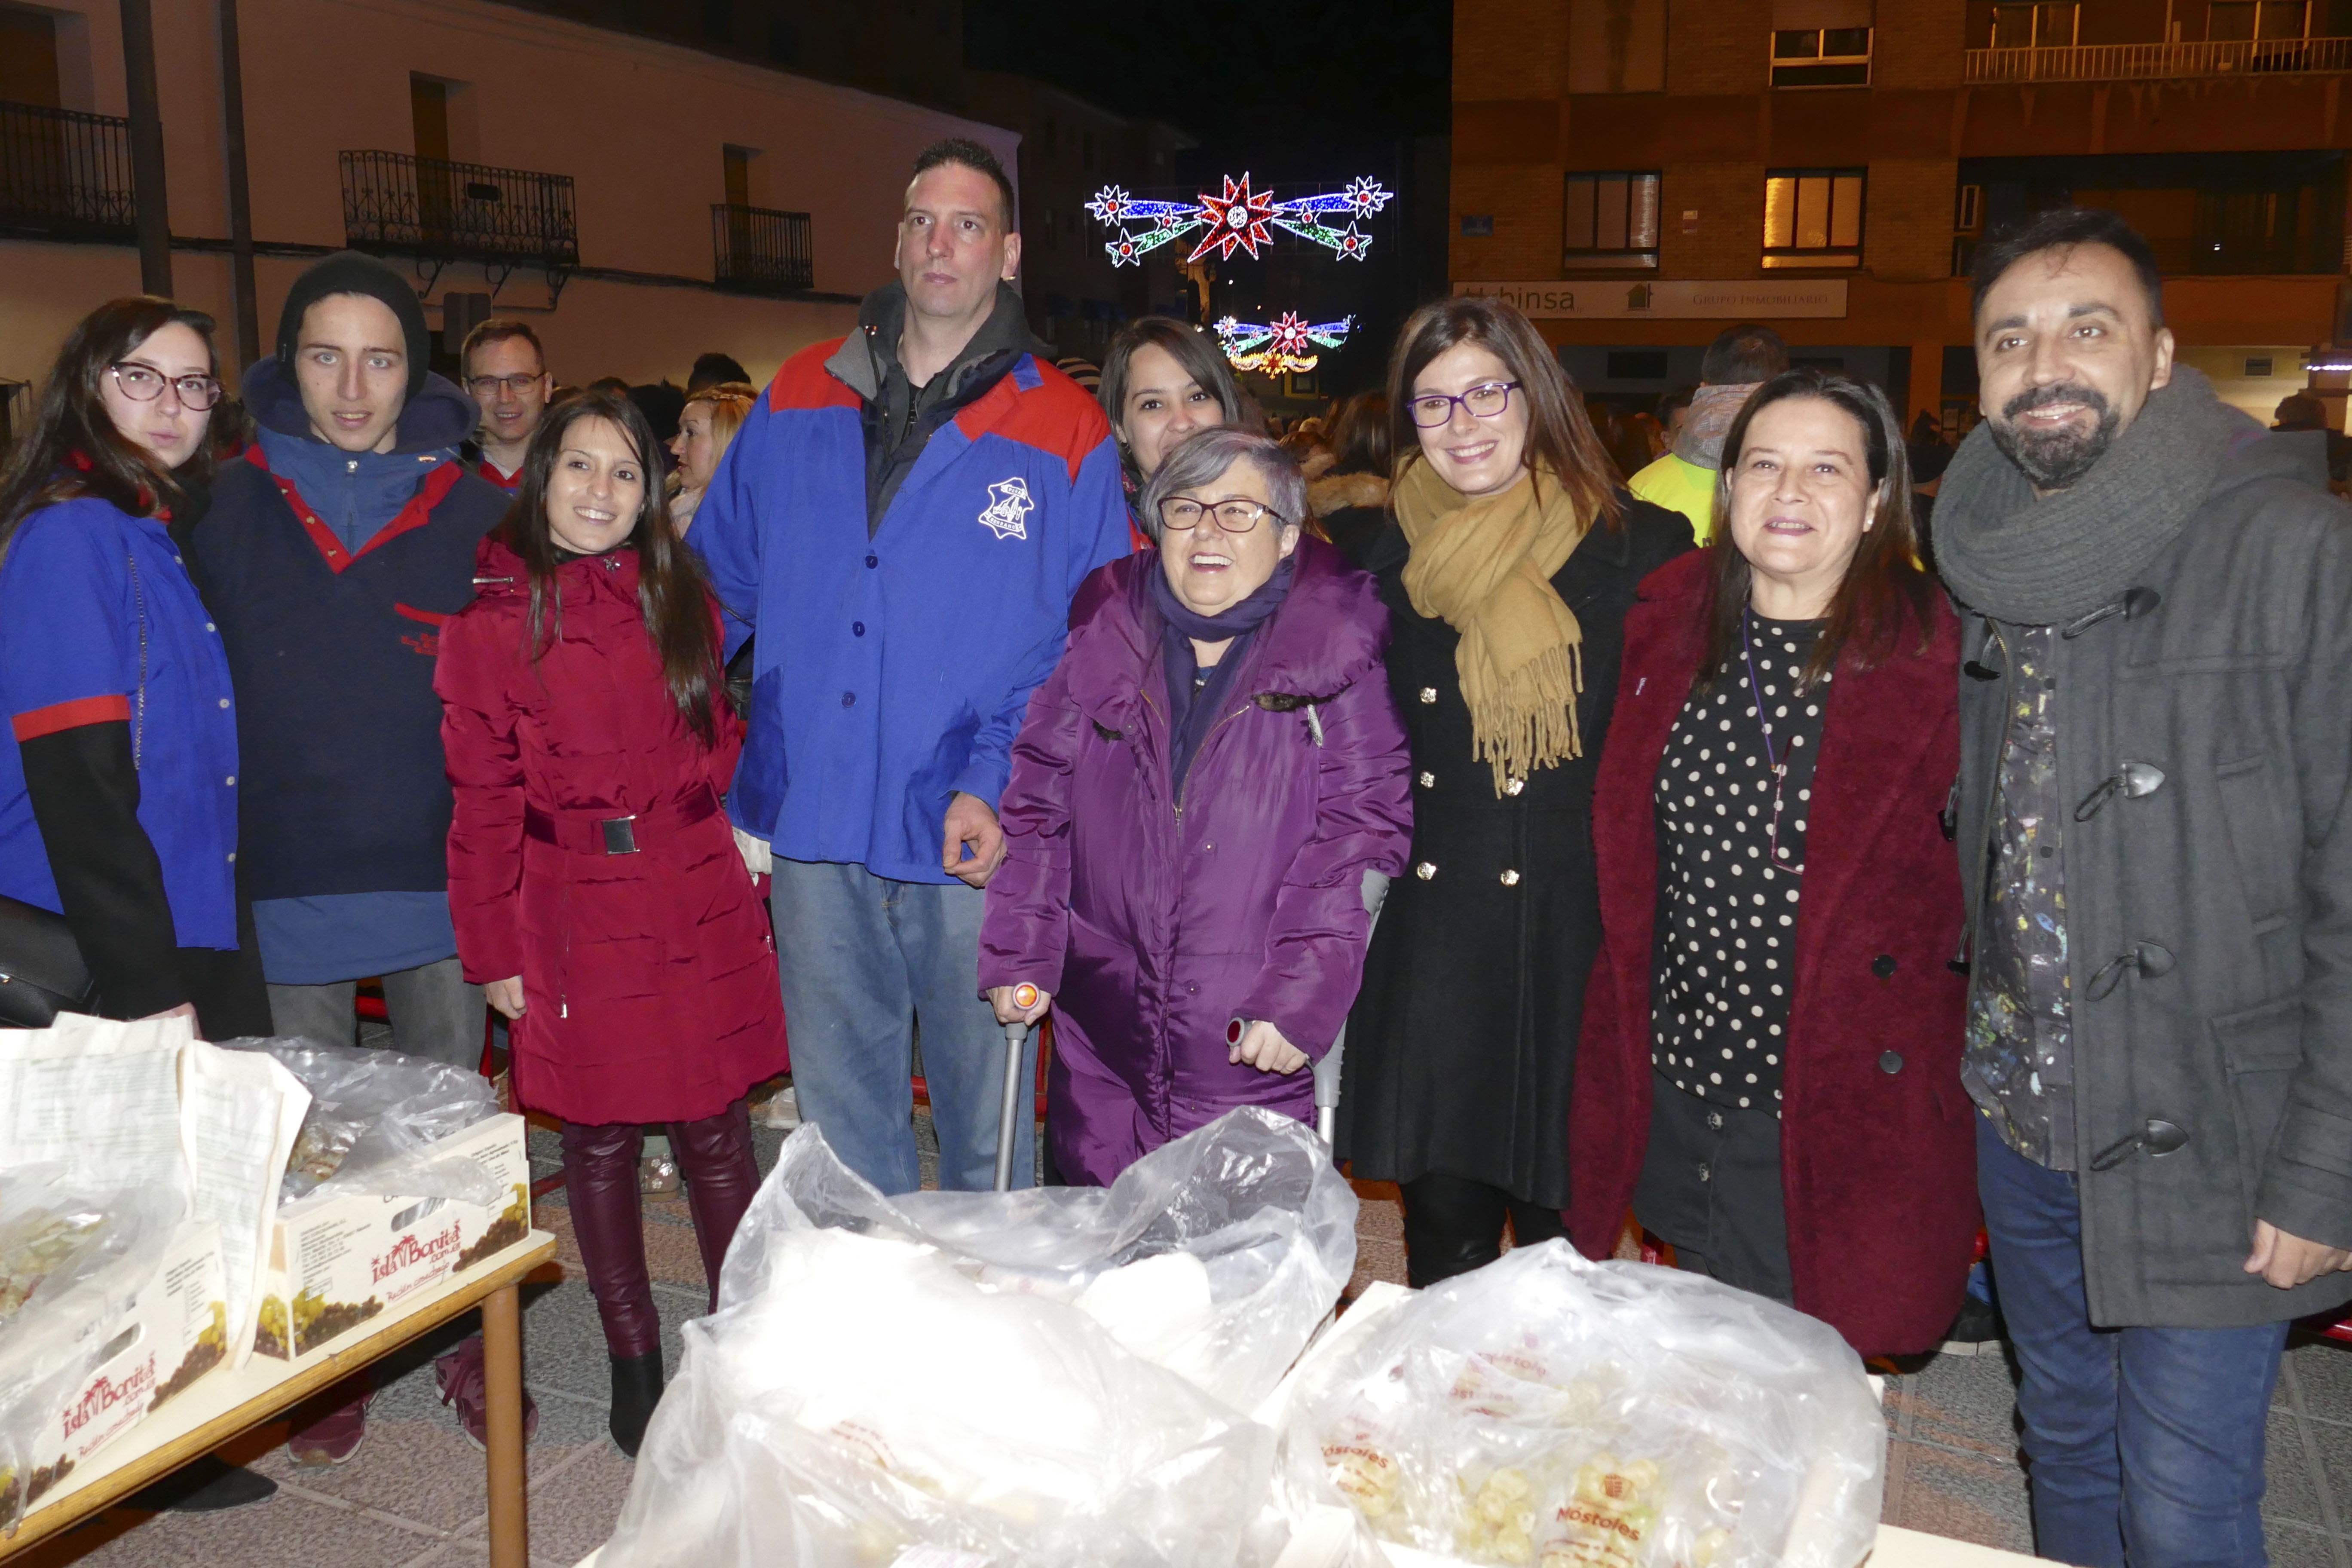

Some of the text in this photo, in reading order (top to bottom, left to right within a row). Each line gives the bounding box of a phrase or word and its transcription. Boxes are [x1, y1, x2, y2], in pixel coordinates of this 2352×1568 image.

[1466, 286, 1574, 309] binsa
[1693, 294, 1736, 305] GRUPO
[990, 518, 1016, 529] SERRANO
[409, 1225, 461, 1266] Bonita
